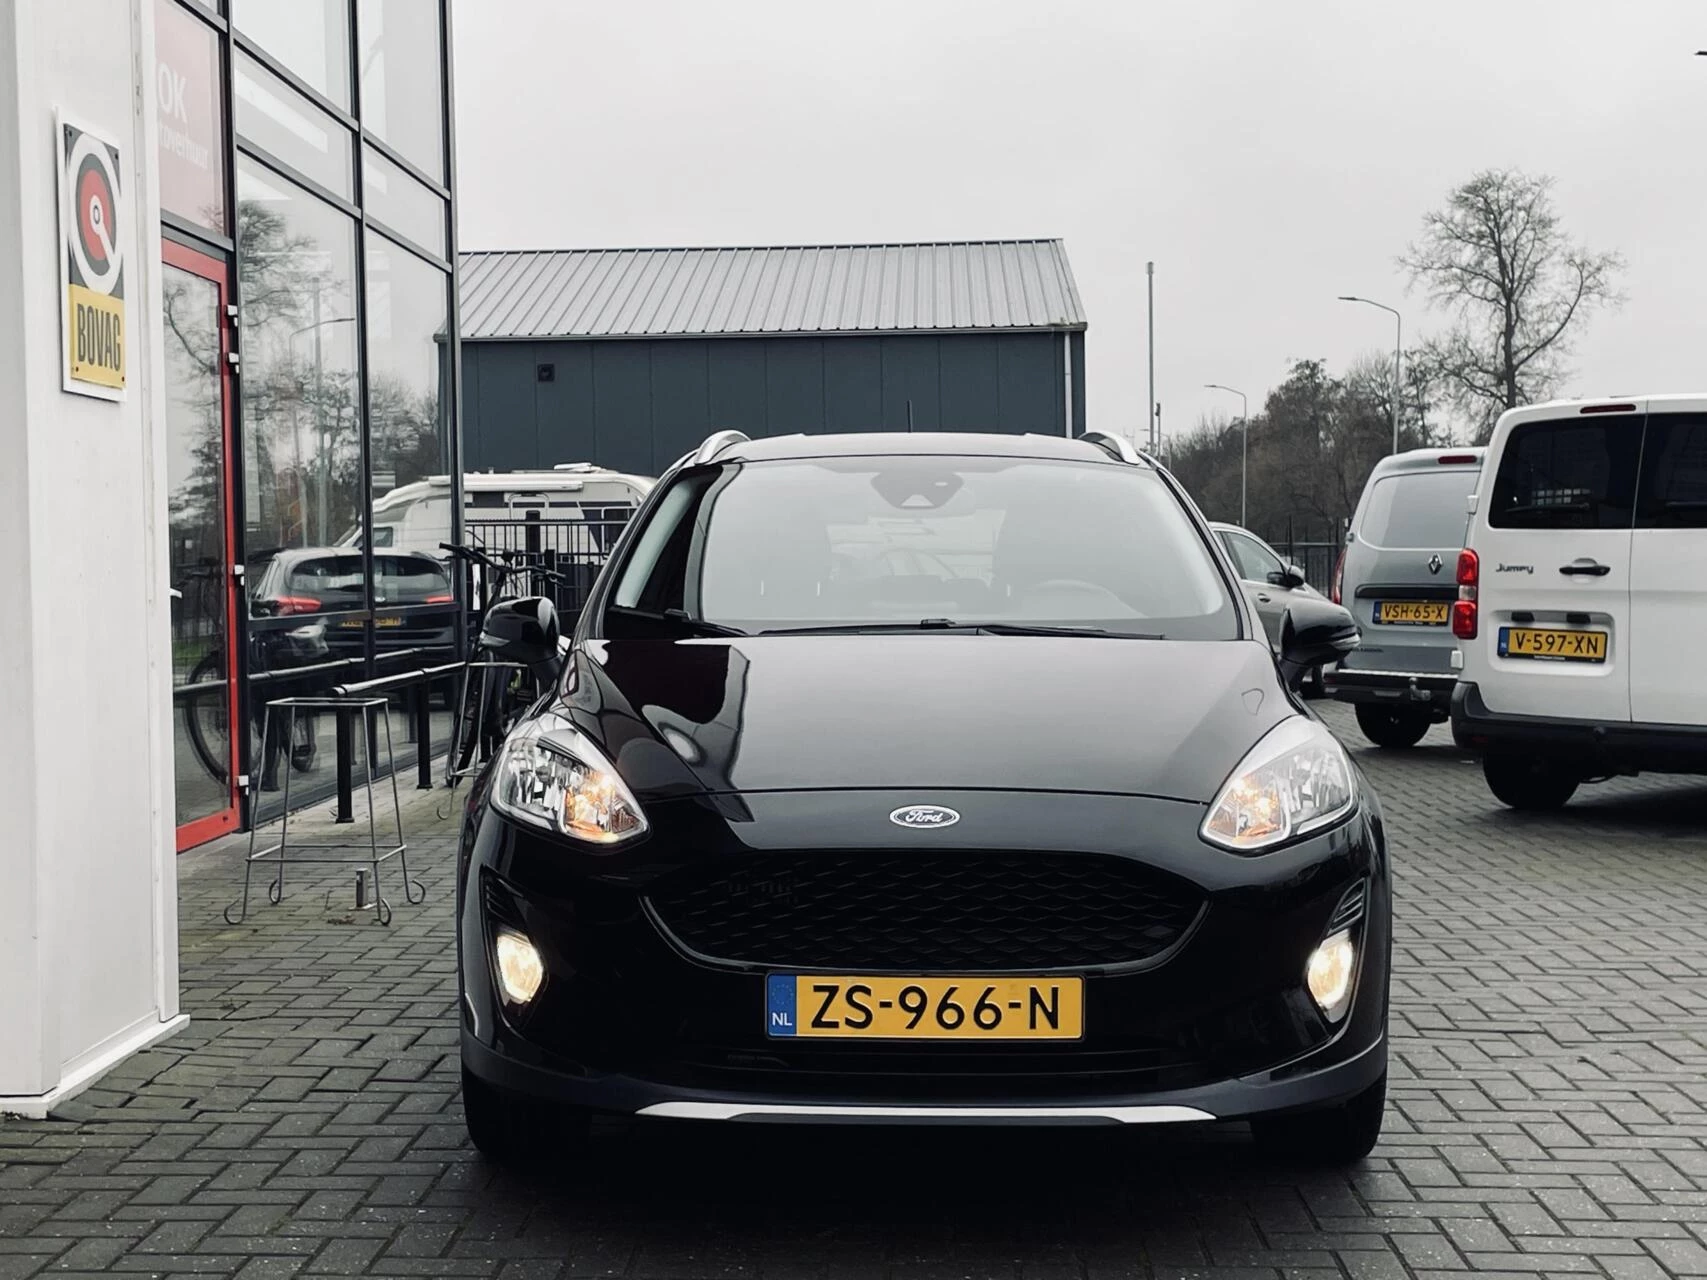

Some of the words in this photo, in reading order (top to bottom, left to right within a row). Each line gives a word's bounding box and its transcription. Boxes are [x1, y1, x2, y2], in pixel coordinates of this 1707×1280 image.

[77, 303, 121, 372] BOVAG
[1496, 563, 1534, 575] Jumpy
[1384, 604, 1445, 620] VSH-65-X
[1515, 632, 1599, 655] V-597-XN
[905, 809, 943, 823] Ford
[771, 1012, 793, 1027] NL
[810, 984, 1060, 1030] ZS-966-N
